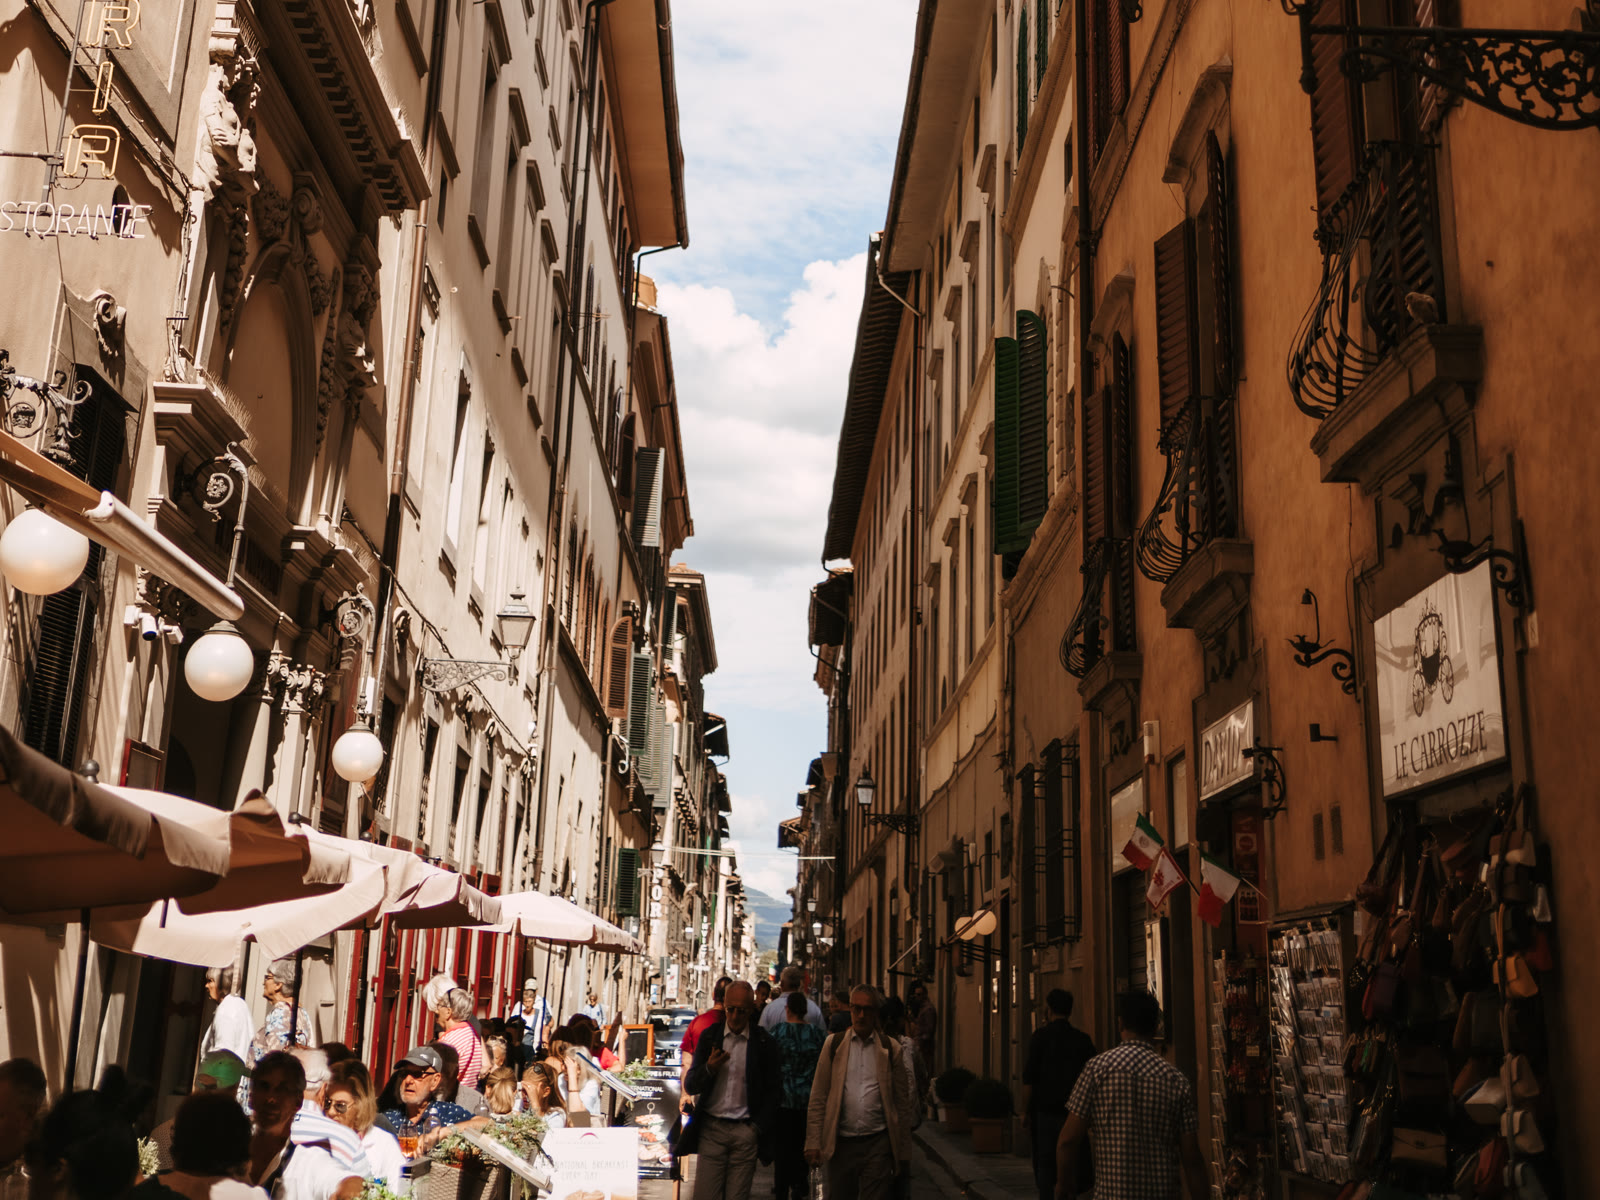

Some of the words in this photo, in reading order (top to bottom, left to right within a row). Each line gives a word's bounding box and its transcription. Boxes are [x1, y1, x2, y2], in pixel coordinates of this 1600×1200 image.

[0, 201, 152, 240] STORANTE
[1394, 742, 1409, 780] LE
[1410, 710, 1488, 774] CARROZZE
[649, 863, 665, 935] PORT
